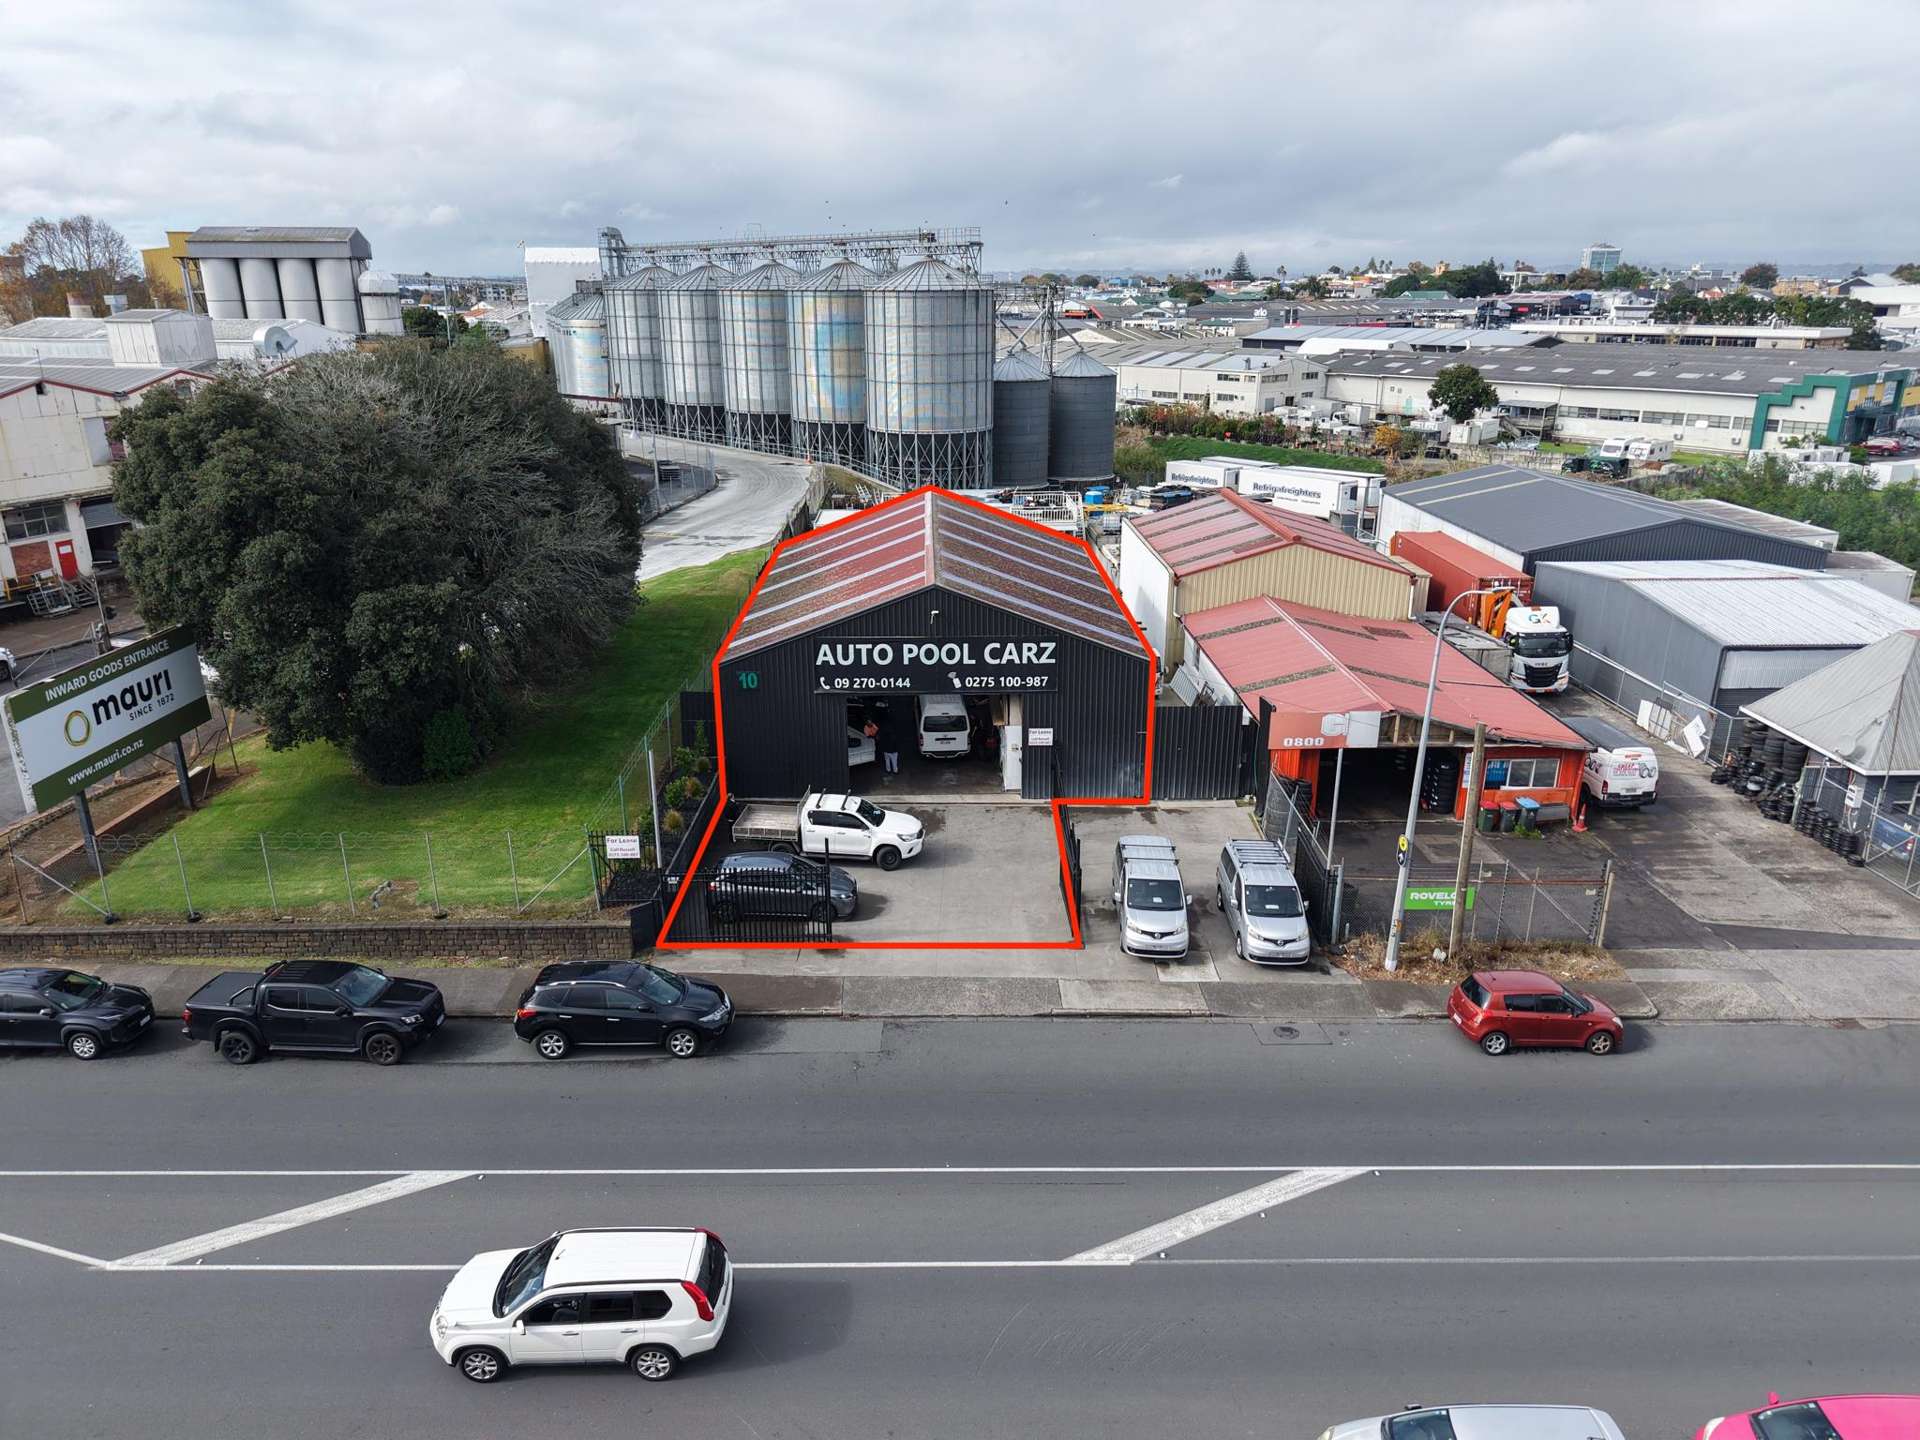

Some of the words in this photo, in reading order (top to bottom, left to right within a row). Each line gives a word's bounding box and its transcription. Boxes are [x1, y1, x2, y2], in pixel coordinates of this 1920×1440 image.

[1253, 482, 1321, 499] Refrigafreighters
[815, 643, 894, 666] AUTO
[902, 643, 976, 666] POOL
[983, 642, 1057, 665] CARZ
[45, 675, 87, 702] INWARD
[88, 661, 123, 682] GOODS
[124, 639, 170, 667] ENTRANCE
[738, 671, 759, 689] 10
[834, 677, 850, 689] 09
[853, 677, 911, 689] 270-0144
[965, 676, 995, 687] 0275
[999, 676, 1049, 687] 100-987
[92, 669, 172, 726] mauri
[129, 703, 154, 721] SINCE
[157, 693, 175, 708] 1872
[1283, 737, 1325, 747] 0800
[67, 739, 145, 785] www.mauri.co.nz
